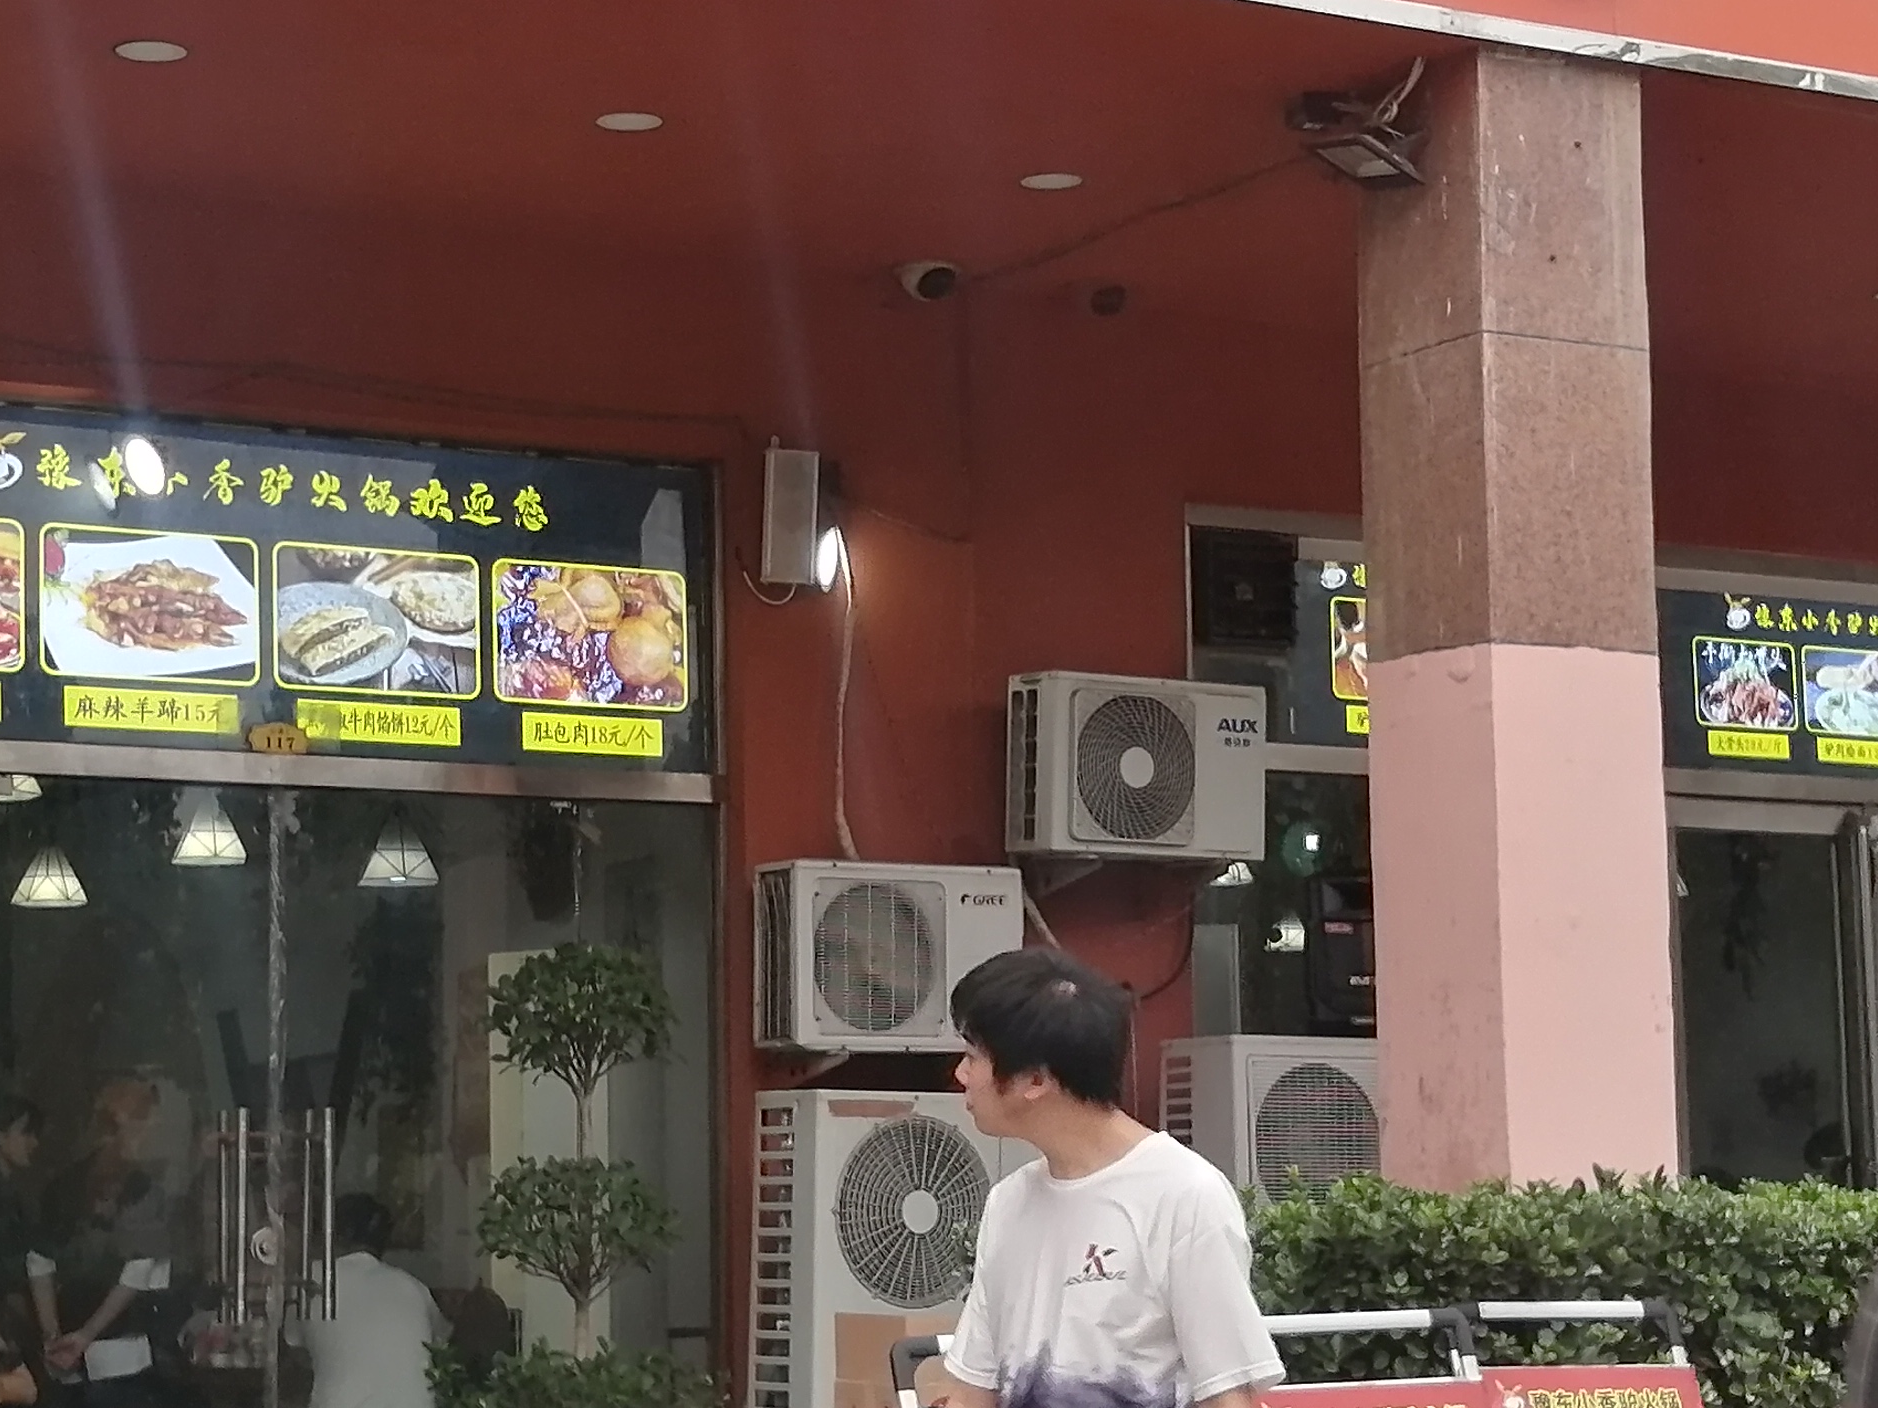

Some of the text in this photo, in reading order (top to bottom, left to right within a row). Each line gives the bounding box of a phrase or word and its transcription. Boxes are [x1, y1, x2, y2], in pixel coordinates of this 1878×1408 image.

[37, 443, 549, 532] 豫东香驴火锅欢迎您
[1217, 718, 1259, 735] AUX
[266, 736, 295, 749] 117
